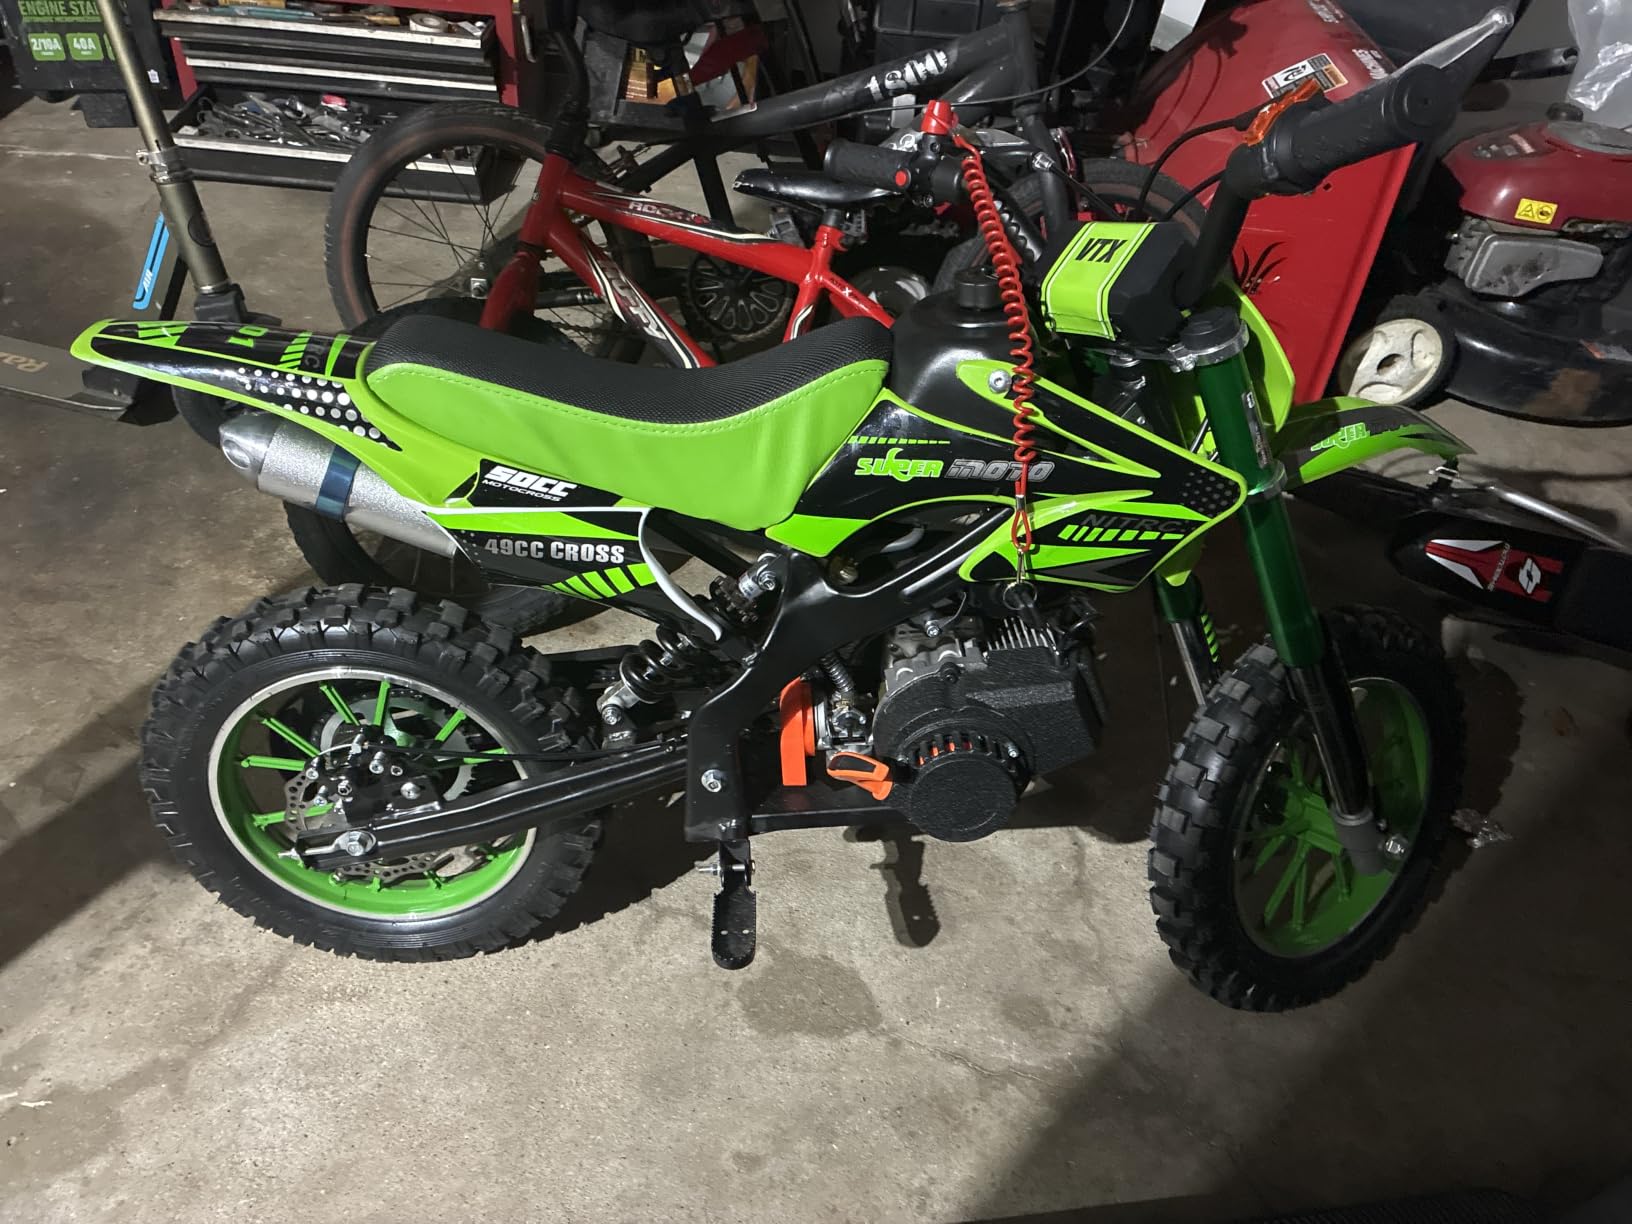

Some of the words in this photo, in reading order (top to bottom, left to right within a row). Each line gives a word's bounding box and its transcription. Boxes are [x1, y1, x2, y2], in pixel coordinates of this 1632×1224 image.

[18, 0, 68, 16] ENGINE
[73, 37, 97, 50] 40A
[1075, 238, 1128, 263] VTX
[481, 479, 562, 502] MOTOCROSS
[484, 538, 544, 559] 49CC
[550, 541, 625, 564] CROSS
